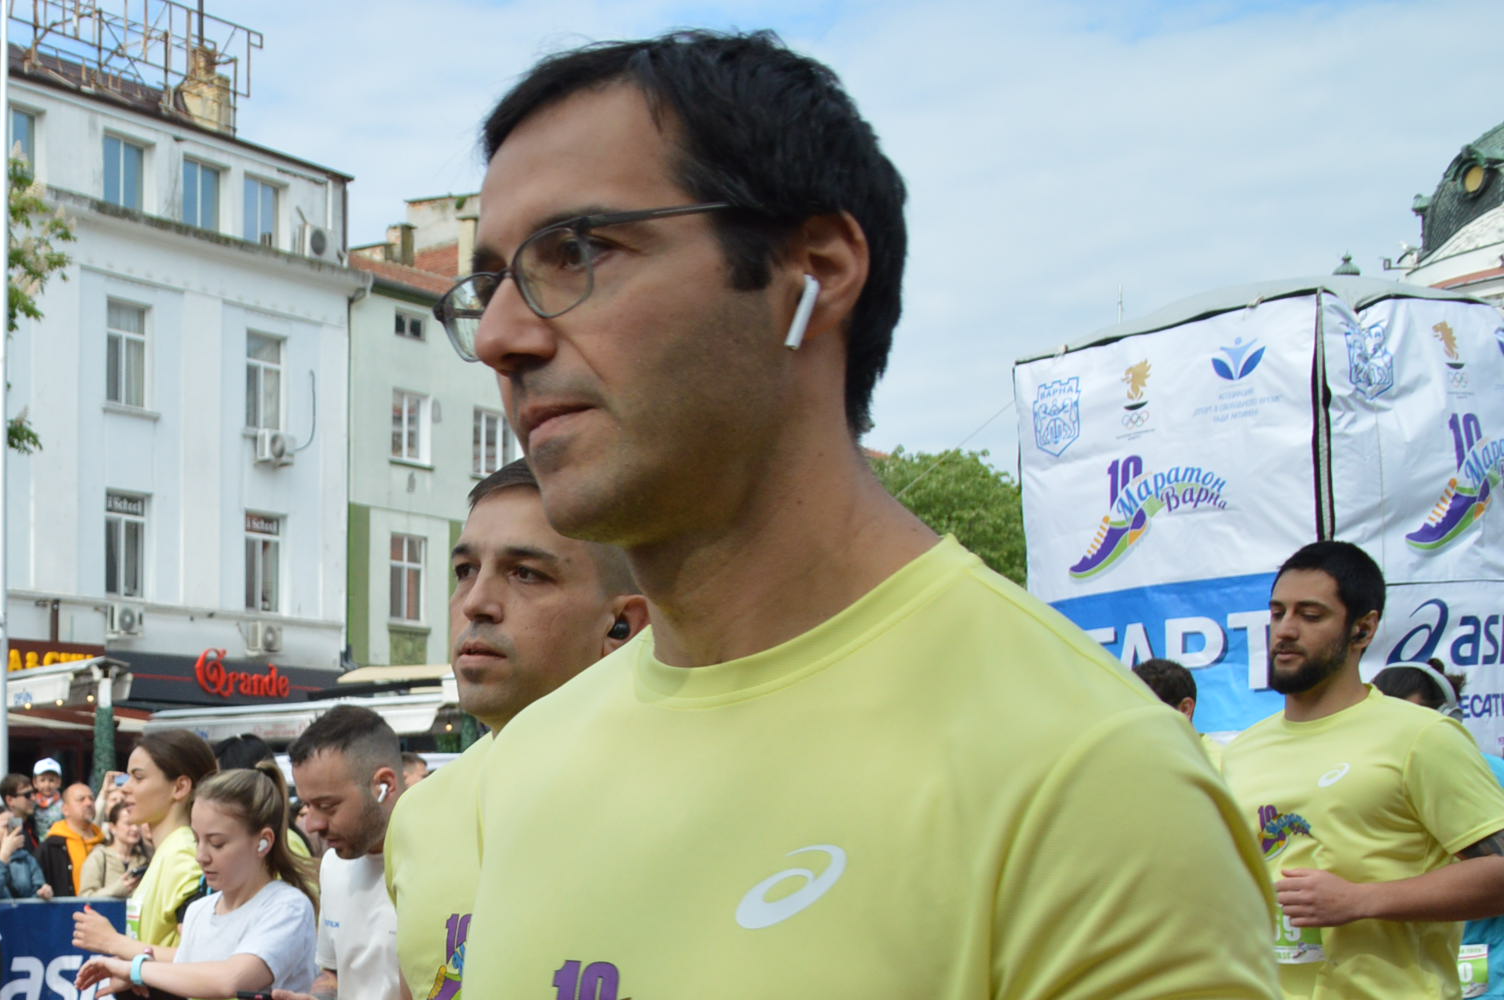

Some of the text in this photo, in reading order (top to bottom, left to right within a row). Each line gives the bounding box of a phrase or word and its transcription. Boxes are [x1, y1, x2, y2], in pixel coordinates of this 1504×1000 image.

[1117, 466, 1227, 524] Маратон
[1160, 485, 1228, 513] Варна
[195, 648, 290, 697] Grande
